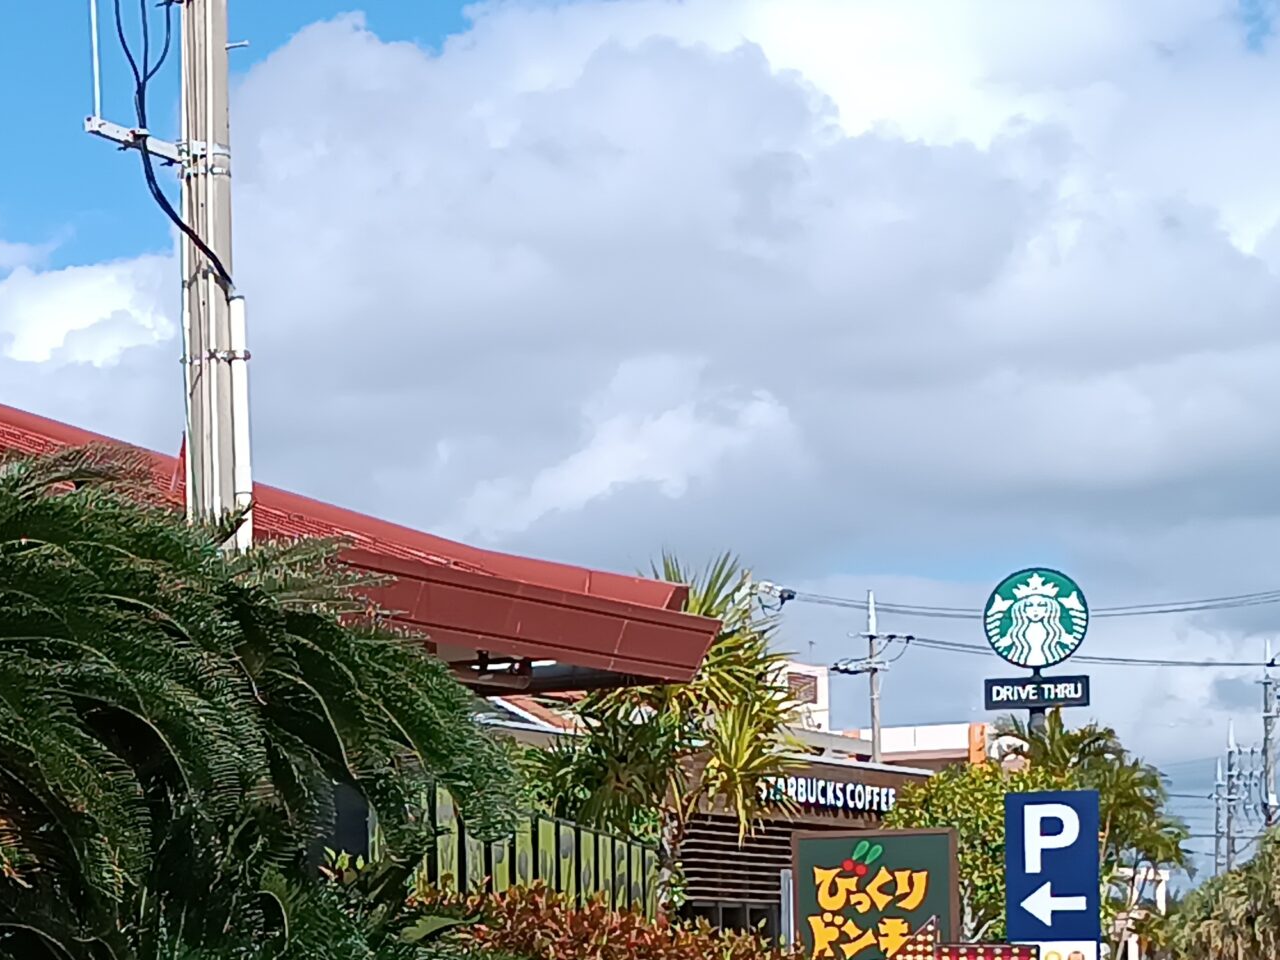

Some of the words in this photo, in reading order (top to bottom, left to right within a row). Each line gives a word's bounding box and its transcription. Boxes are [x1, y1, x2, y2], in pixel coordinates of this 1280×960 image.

[992, 684, 1038, 702] DRIVE
[1041, 682, 1082, 700] THRU
[755, 776, 843, 807] STARBUCKS
[846, 783, 896, 811] COFFEE
[1023, 803, 1080, 874] P
[813, 866, 928, 914] びっくり
